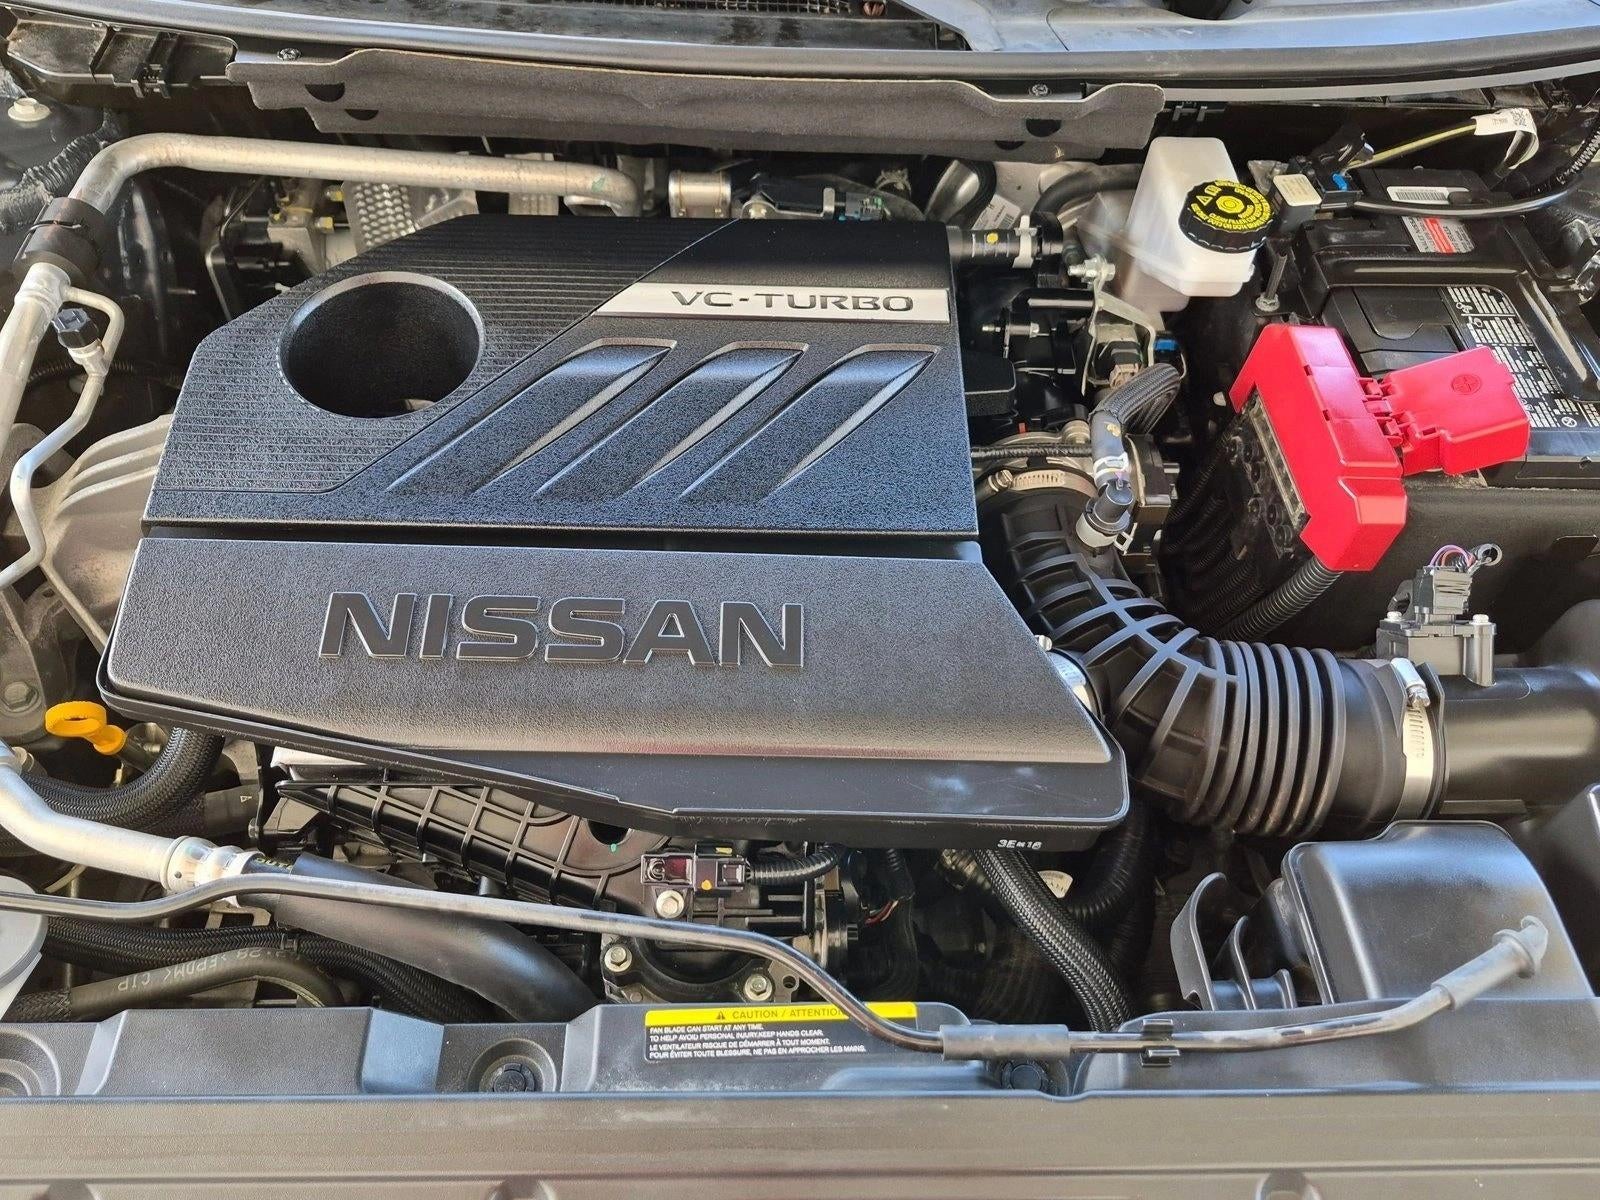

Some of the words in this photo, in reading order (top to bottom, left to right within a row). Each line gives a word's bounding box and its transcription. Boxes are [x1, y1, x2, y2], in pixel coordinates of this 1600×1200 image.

[671, 291, 914, 312] VC-TURBO
[319, 592, 804, 668] NISSAN
[732, 1010, 778, 1019] CAUTION
[659, 1043, 702, 1051] VENTILATEUR
